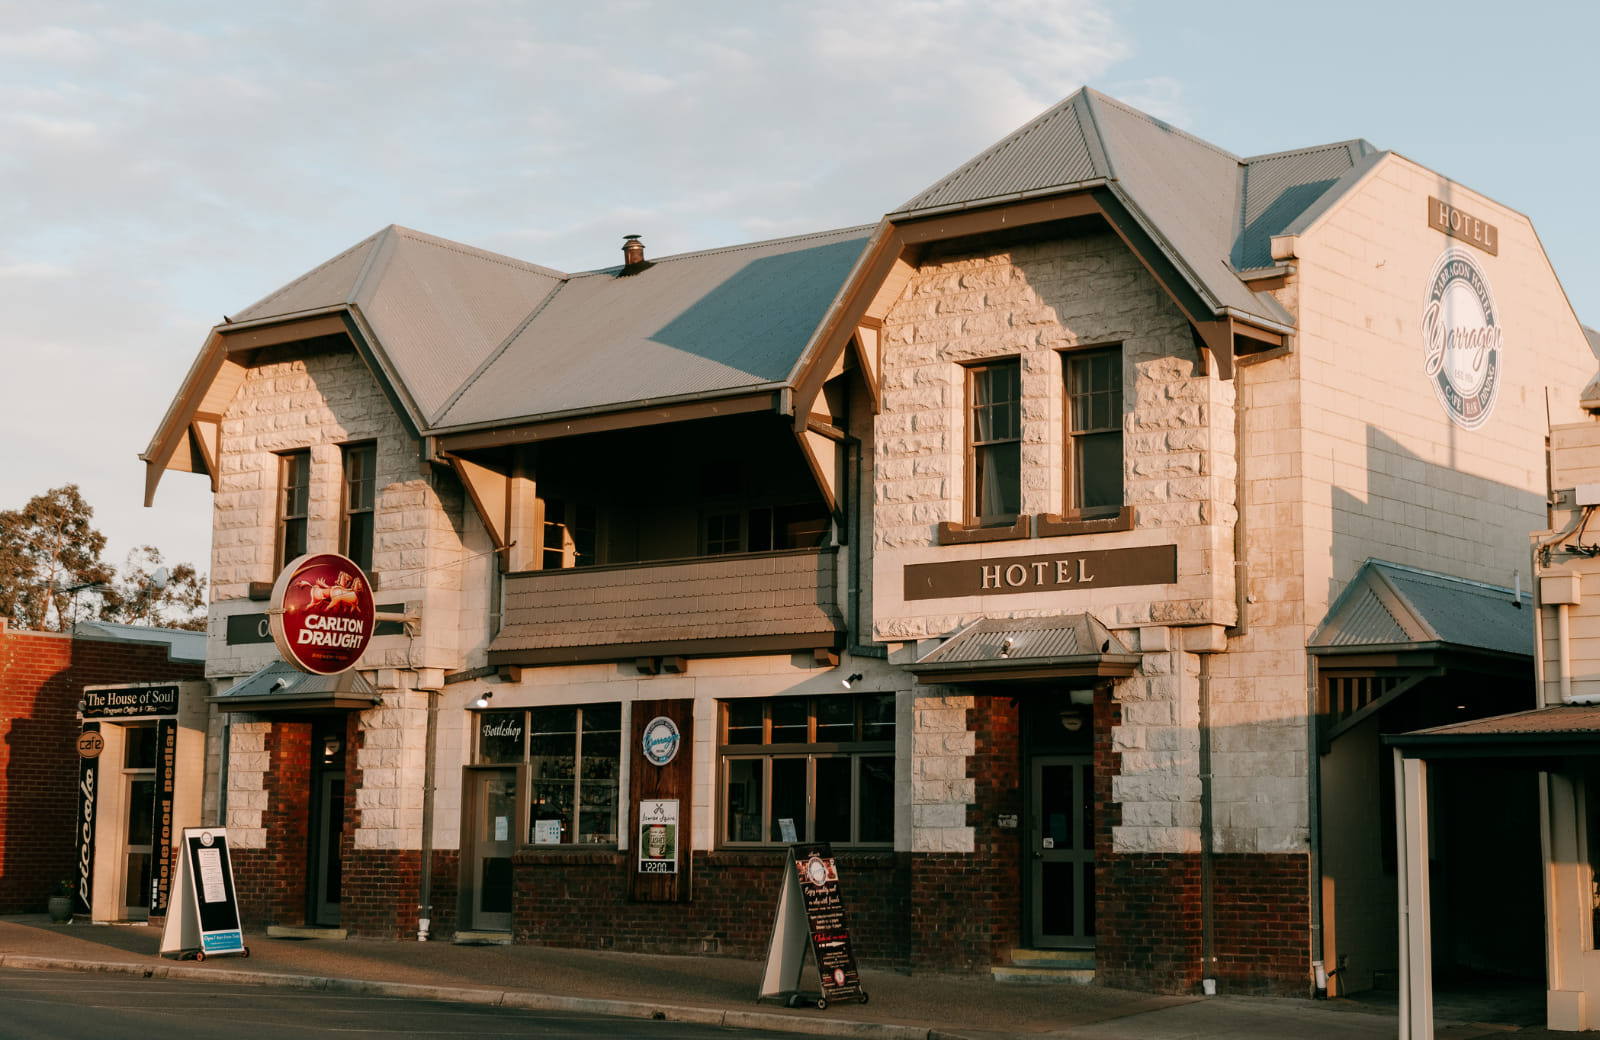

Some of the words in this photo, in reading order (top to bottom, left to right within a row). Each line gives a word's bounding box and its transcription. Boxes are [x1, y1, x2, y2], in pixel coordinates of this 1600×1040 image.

[1437, 202, 1493, 248] HOTEL
[1433, 261, 1471, 298] YARRAGON
[1471, 272, 1492, 321] HOTEL
[1421, 302, 1503, 377] Yarragon
[1479, 363, 1496, 406] DINING
[980, 558, 1096, 590] HOTEL
[297, 628, 364, 649] DRAUGHT
[304, 613, 364, 634] CARLTON
[87, 693, 105, 706] The
[107, 692, 137, 706] House
[139, 690, 152, 704] of
[152, 689, 174, 703] Soul
[79, 736, 102, 750] cafe
[482, 719, 522, 743] Bottleshop
[164, 725, 176, 793] pedlar
[79, 767, 95, 911] piccolo
[159, 799, 172, 911] wholefood
[151, 877, 159, 911] THE
